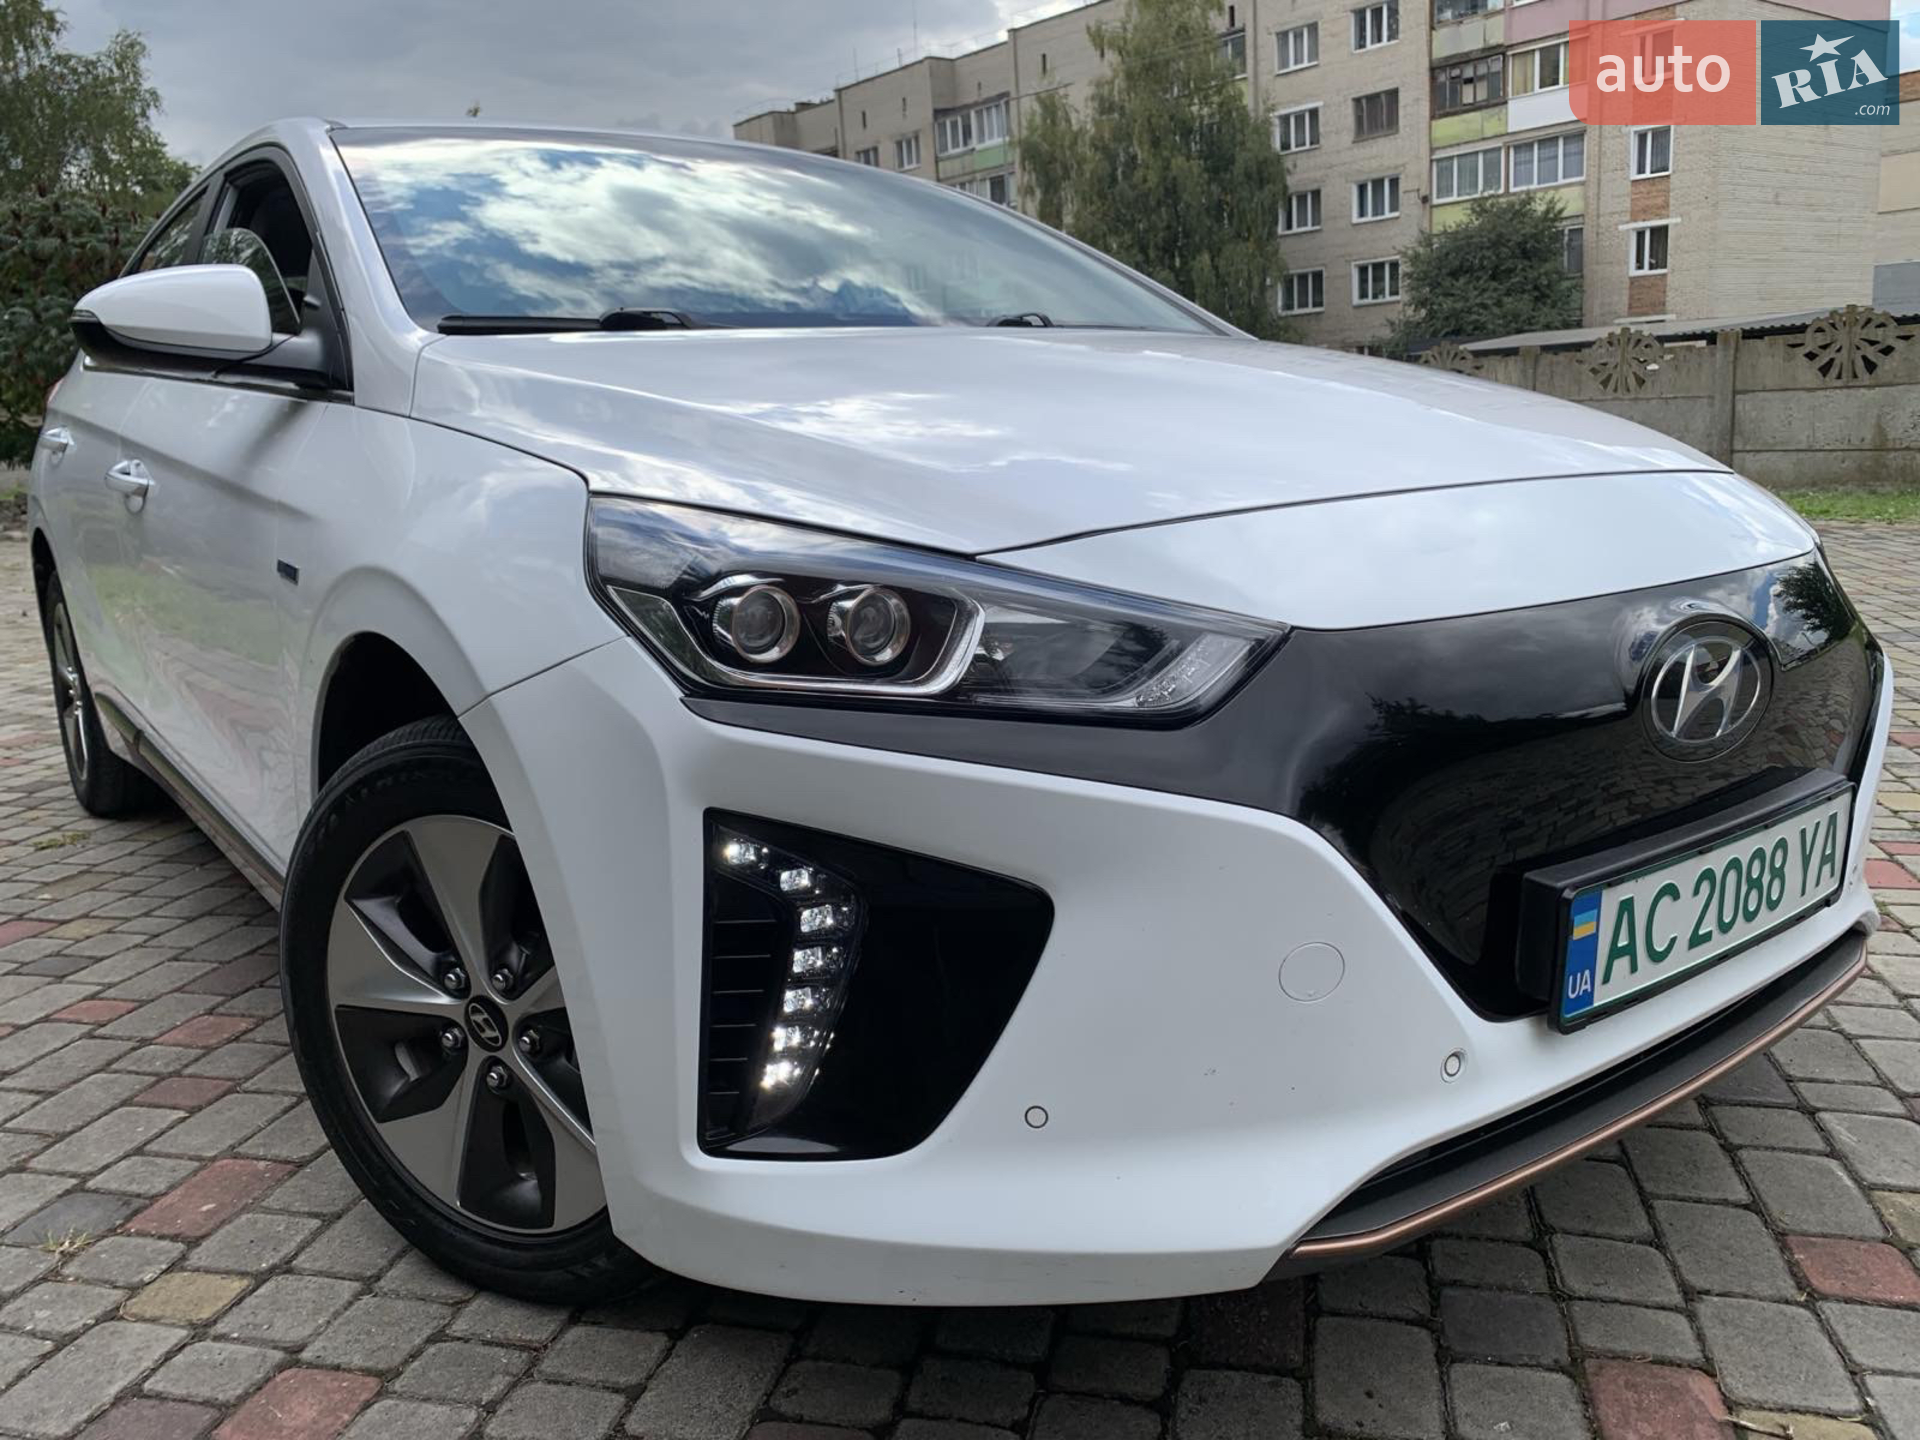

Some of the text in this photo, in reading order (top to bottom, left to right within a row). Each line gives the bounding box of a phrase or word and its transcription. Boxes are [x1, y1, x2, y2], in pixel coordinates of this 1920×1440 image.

[1602, 811, 1839, 985] AC 2088 YA
[1567, 969, 1592, 999] UA
